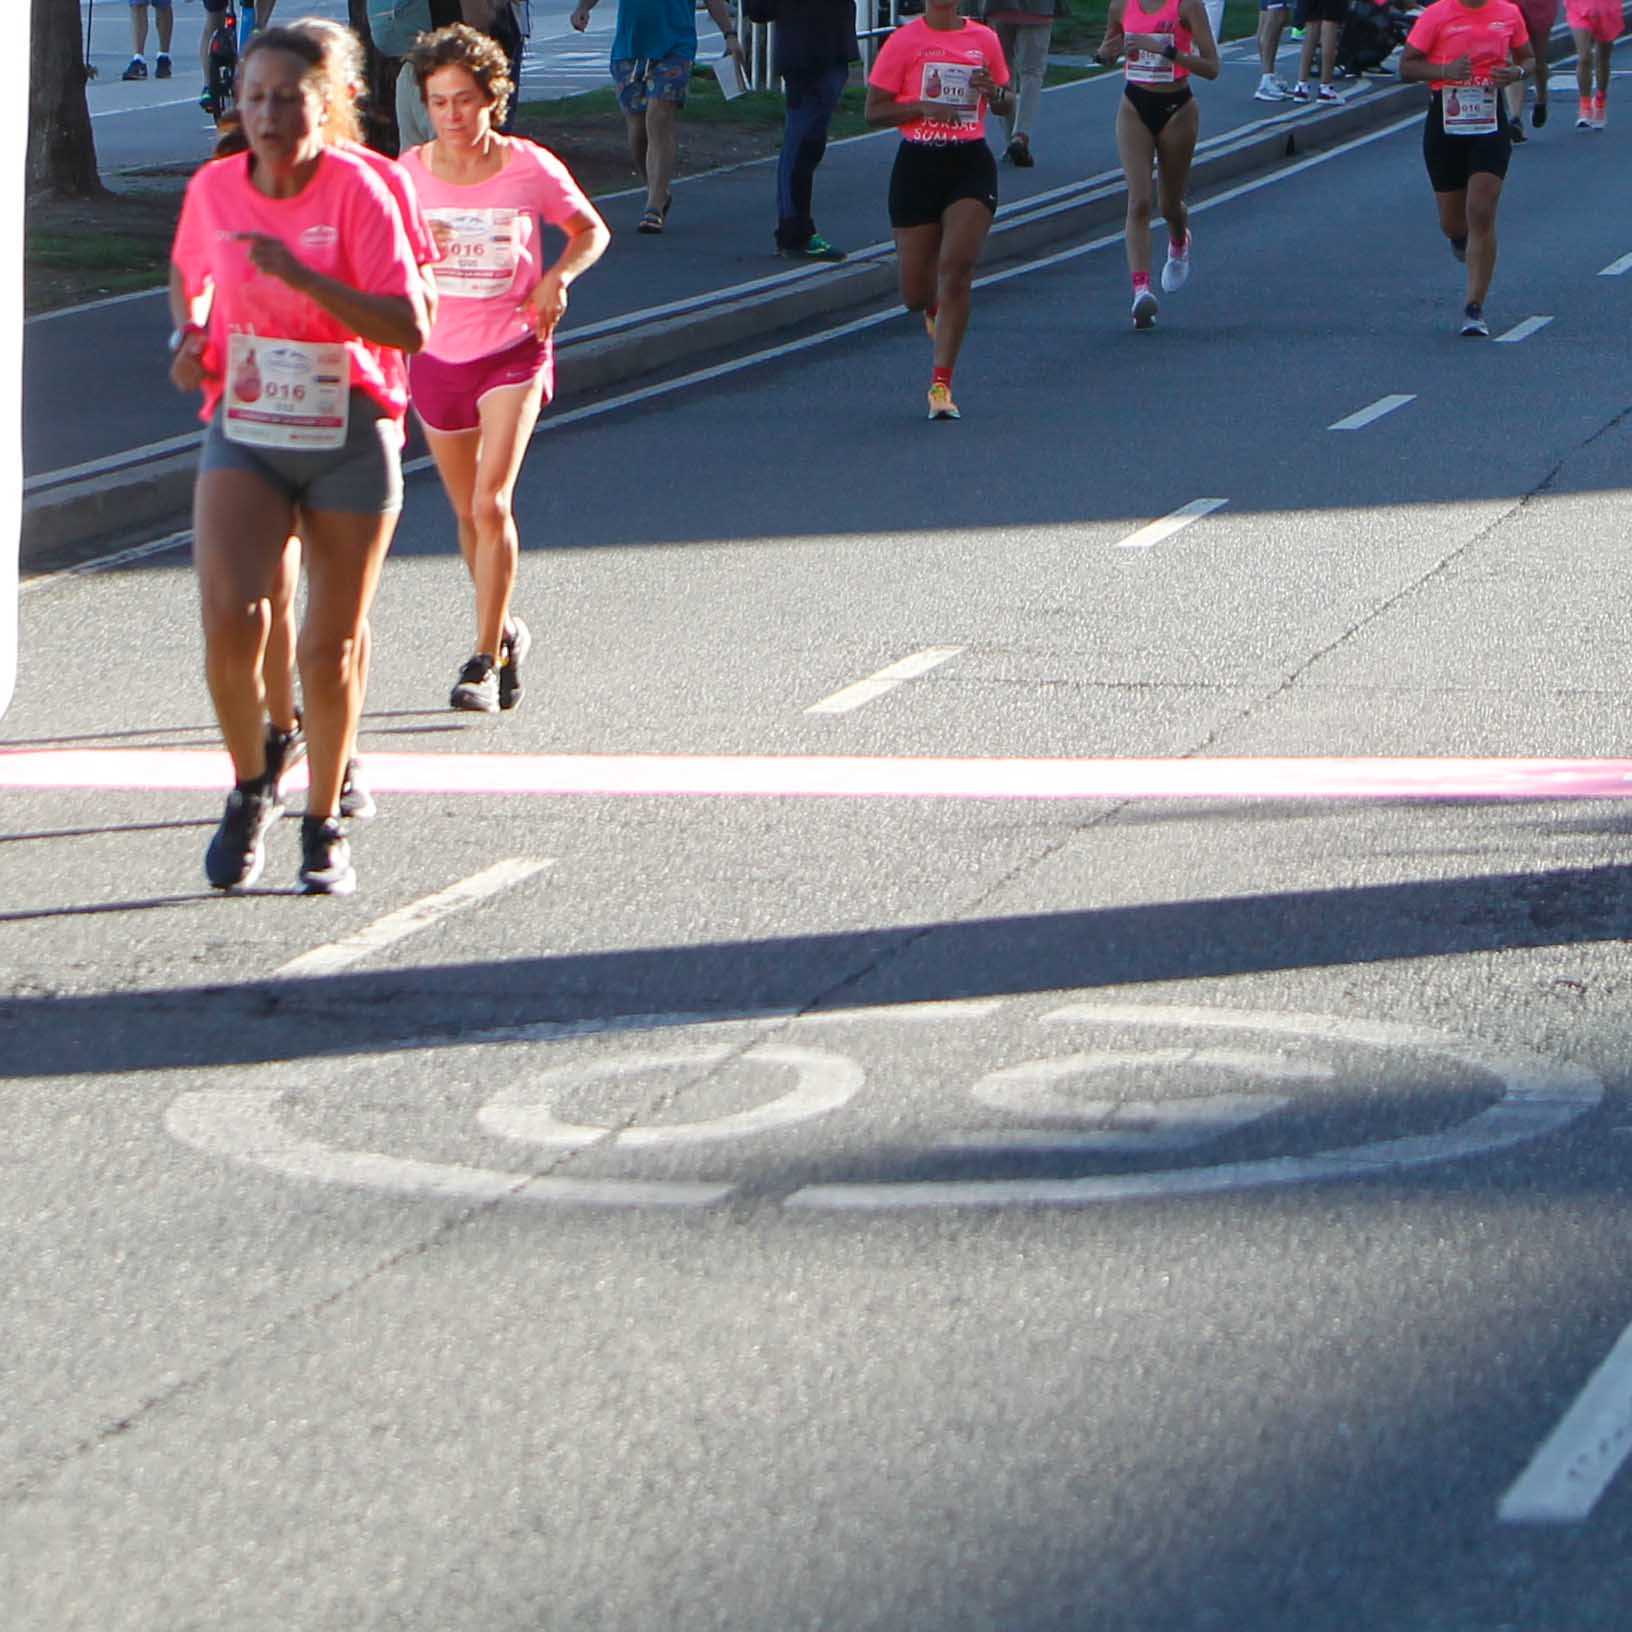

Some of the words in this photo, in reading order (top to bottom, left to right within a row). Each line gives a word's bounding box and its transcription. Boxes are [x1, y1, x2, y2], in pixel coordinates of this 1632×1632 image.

[450, 243, 485, 256] 016
[264, 381, 307, 401] 016
[477, 1044, 1335, 1151] 50
